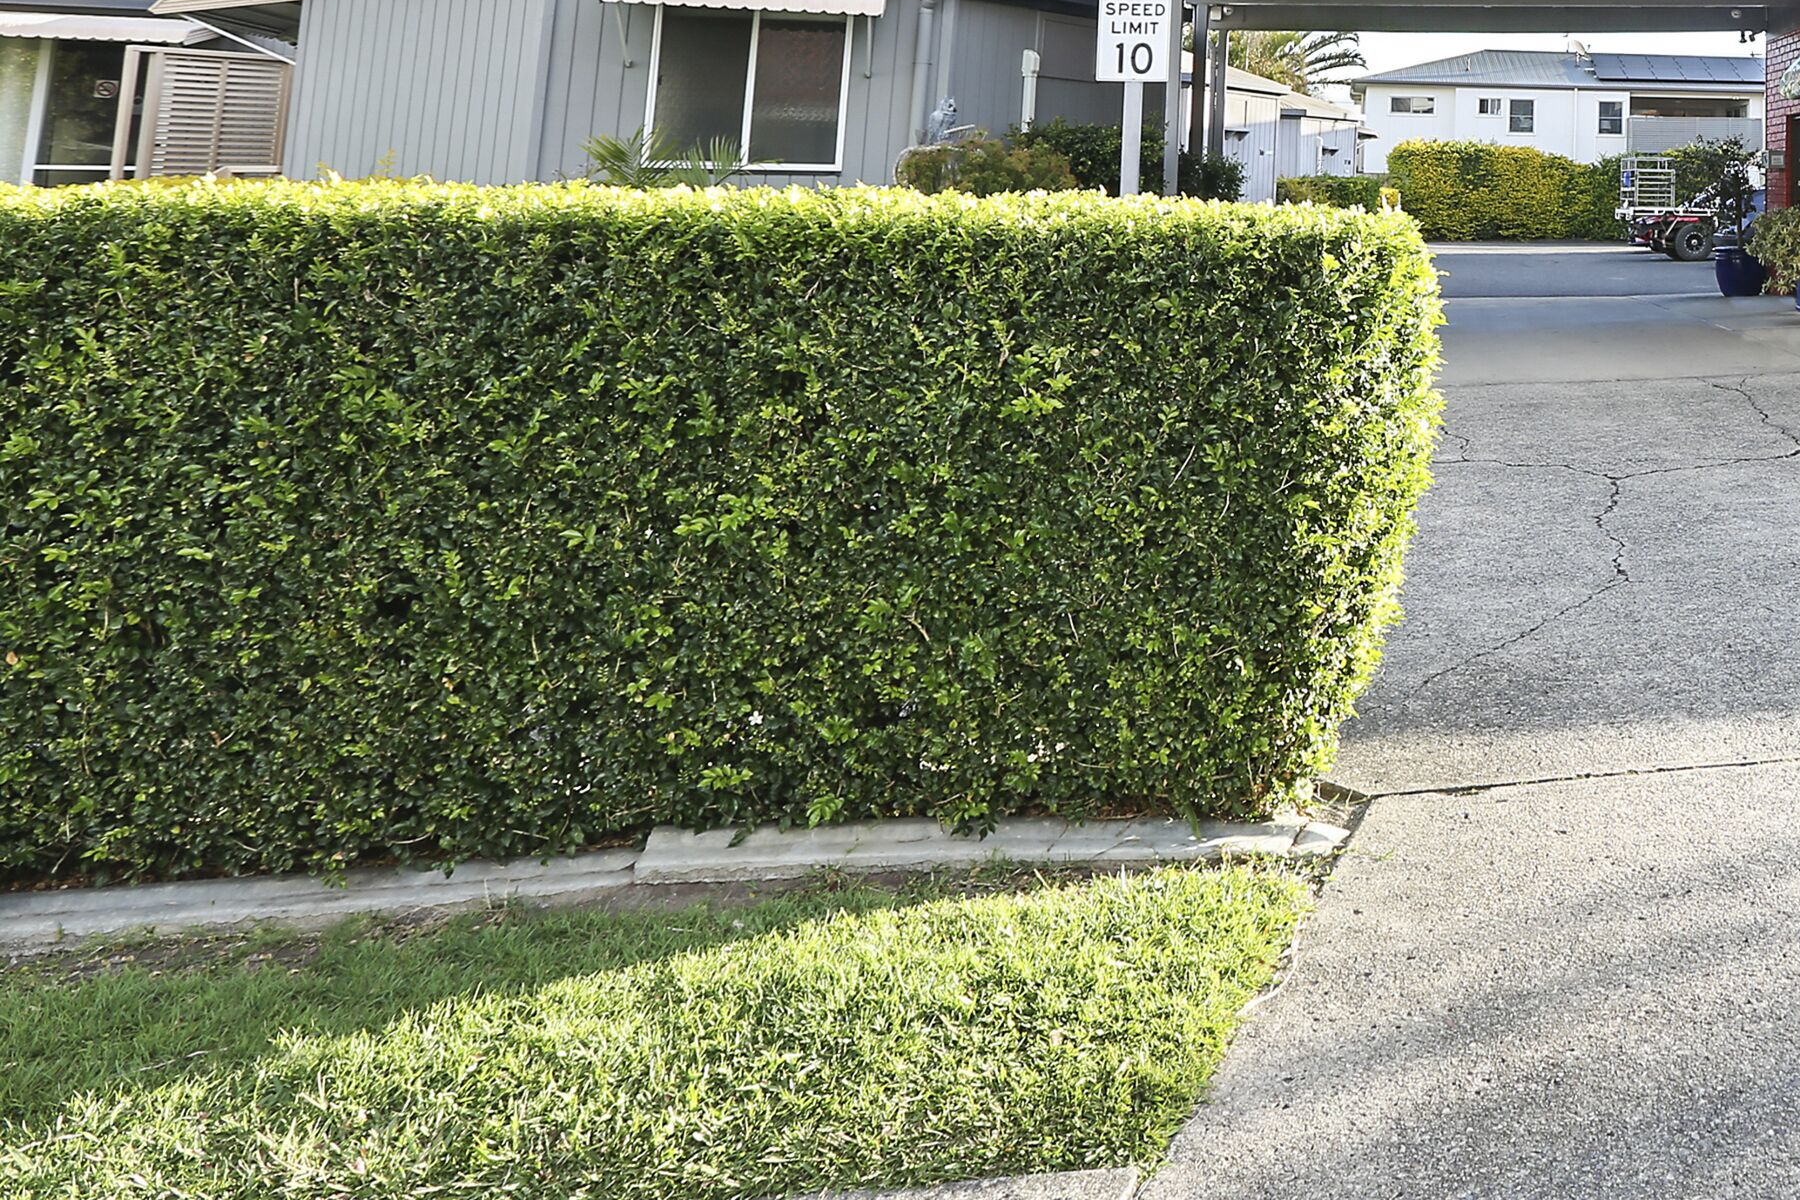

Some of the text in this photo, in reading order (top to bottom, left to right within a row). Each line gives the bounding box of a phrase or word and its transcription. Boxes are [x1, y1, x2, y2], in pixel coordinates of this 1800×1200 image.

[1105, 2, 1165, 16] SPEED
[1111, 21, 1159, 35] LIMIT
[1116, 42, 1153, 74] 10
